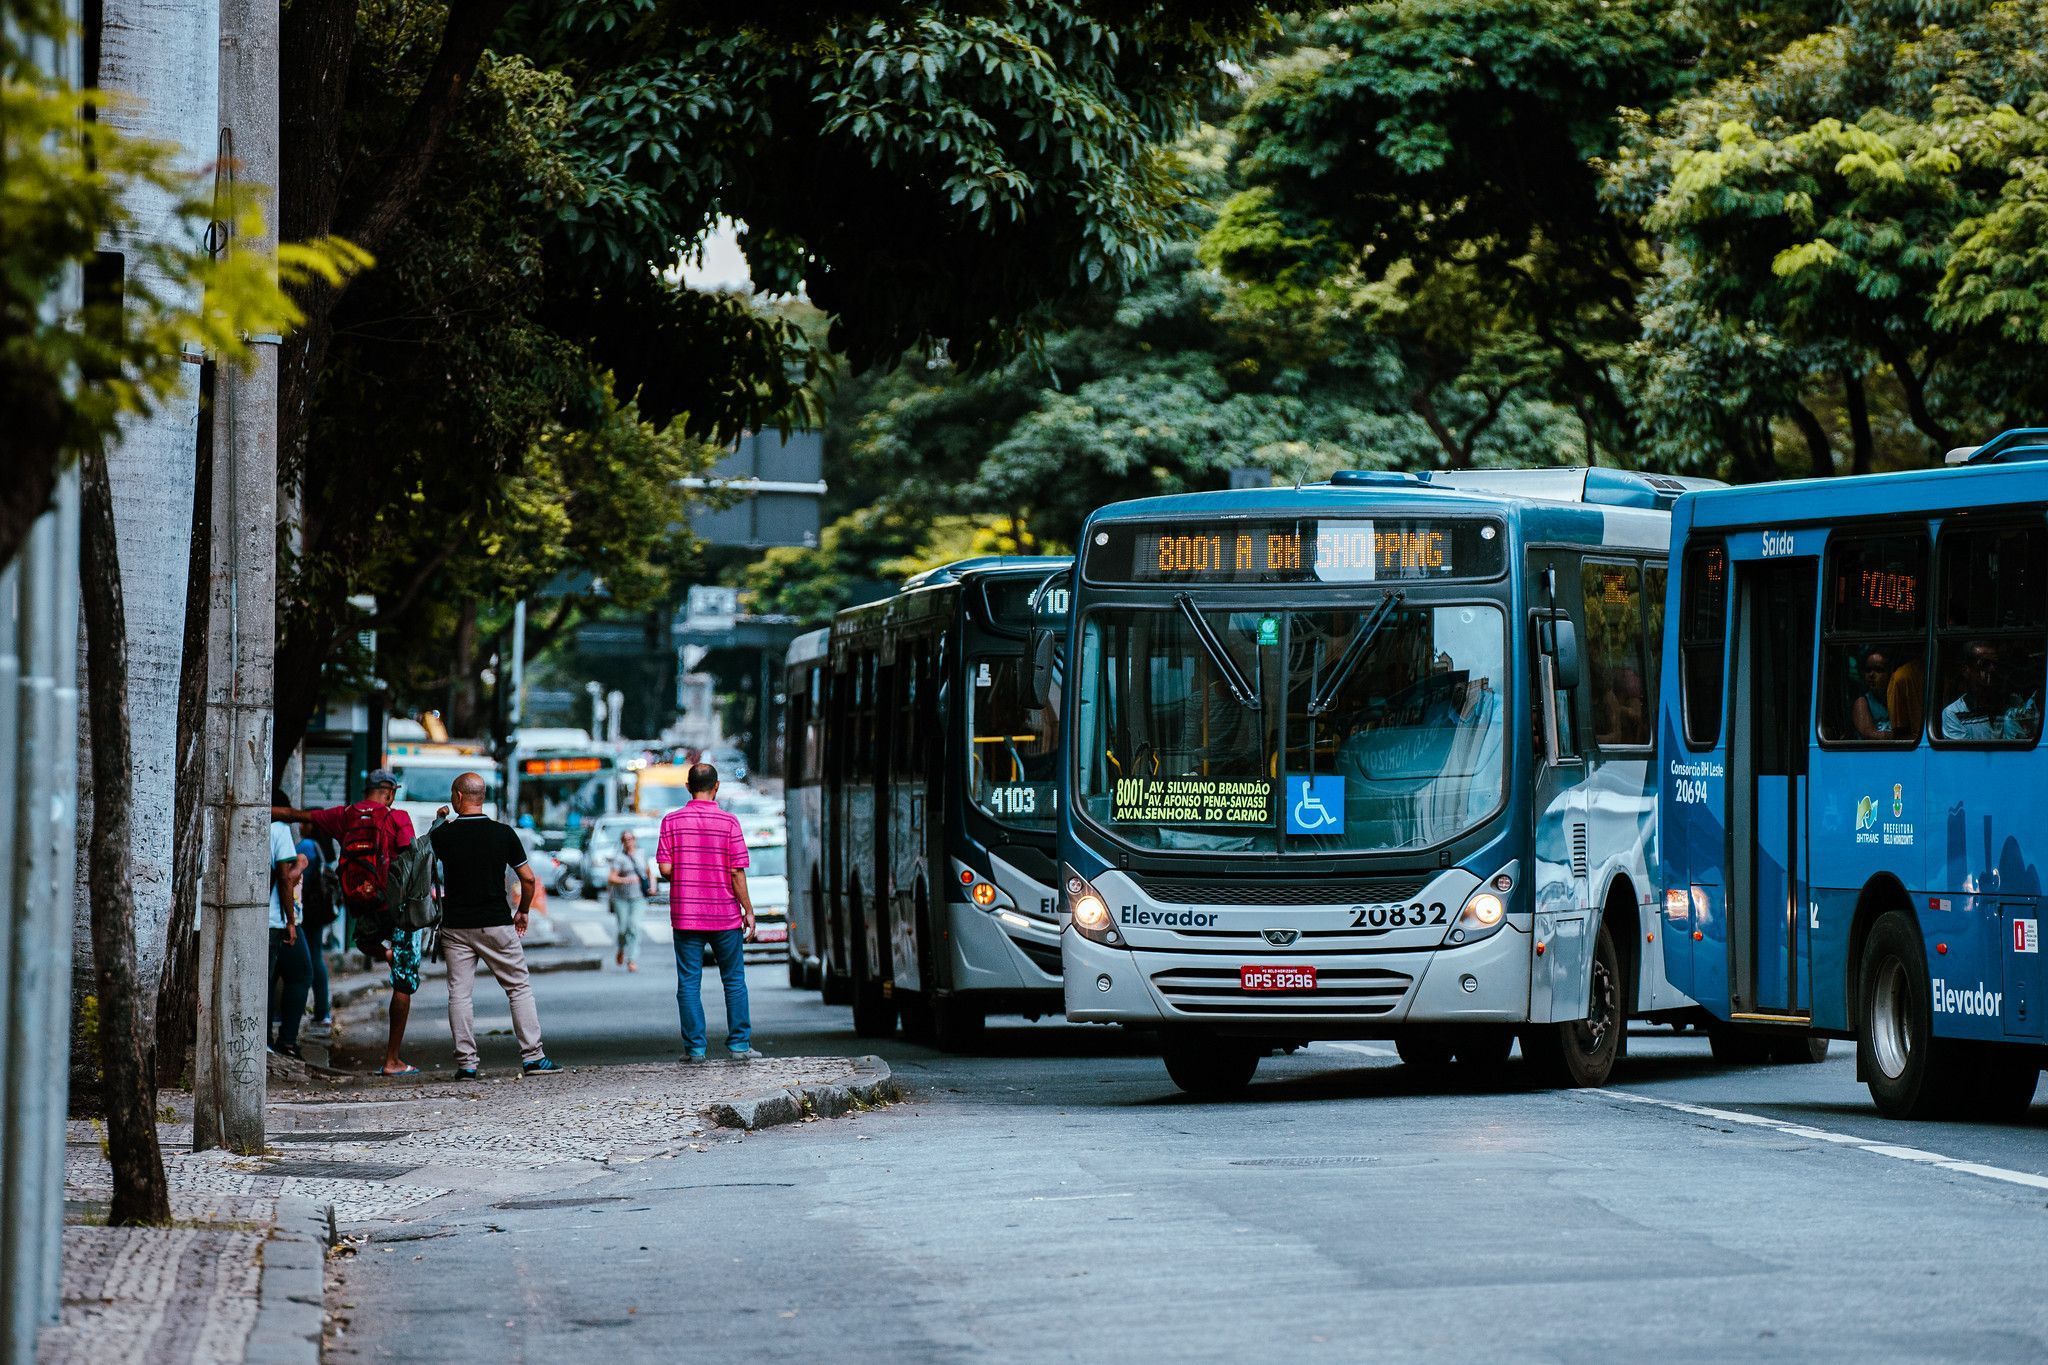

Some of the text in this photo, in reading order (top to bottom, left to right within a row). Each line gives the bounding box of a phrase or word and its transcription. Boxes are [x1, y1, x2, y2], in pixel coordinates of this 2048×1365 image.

[1158, 532, 1443, 571] 8001 A BH SHOPPING
[1762, 530, 1794, 557] Saída
[991, 787, 1035, 813] 4103
[1149, 781, 1164, 794] AV.
[1167, 781, 1216, 795] SILVIANO
[1218, 780, 1271, 795] BRANDÃO
[1675, 778, 1707, 804] 20694
[1148, 795, 1266, 809] AV. AFONSO PENA-SAVASSI
[1205, 809, 1223, 821] DO
[1226, 809, 1268, 822] CARMO
[1121, 904, 1218, 927] Elevador
[1349, 902, 1447, 928] 20832
[1932, 978, 2002, 1017] Elevador
